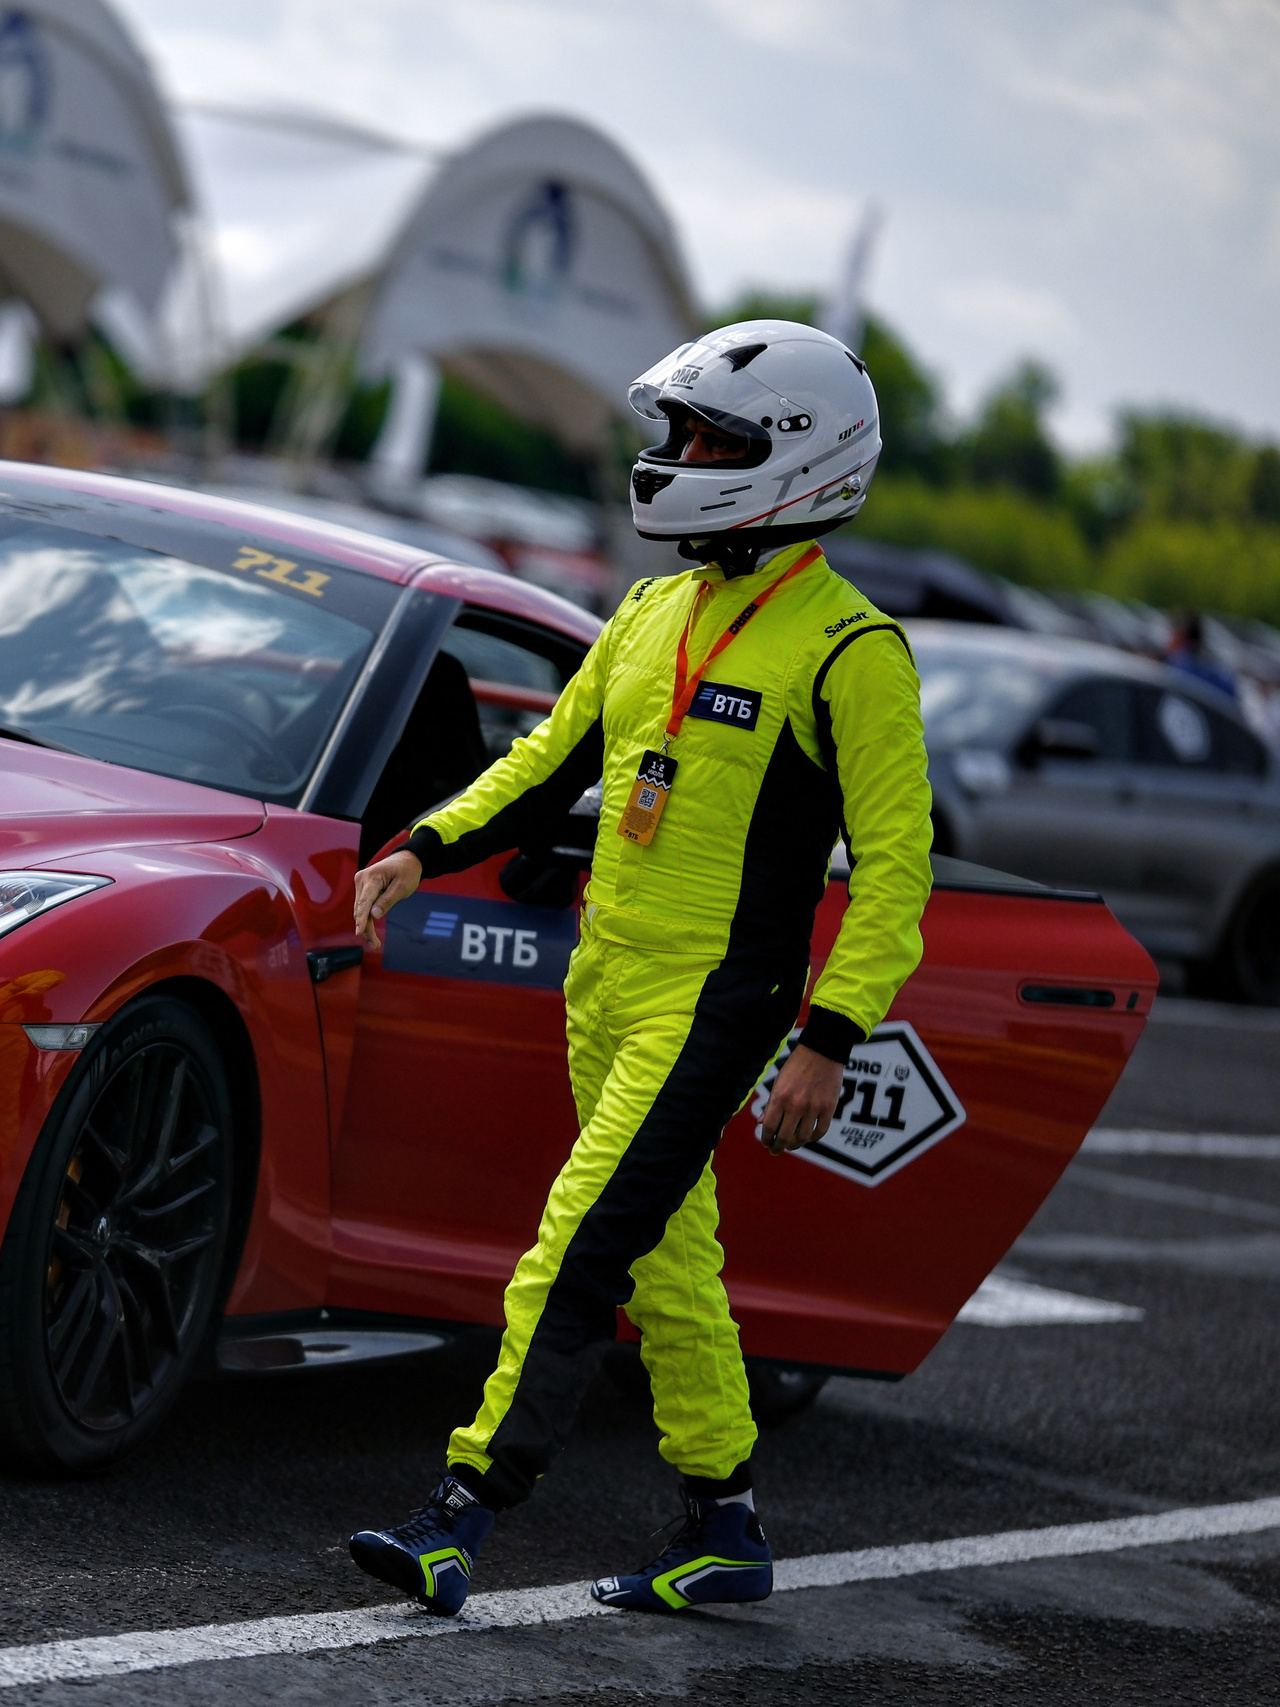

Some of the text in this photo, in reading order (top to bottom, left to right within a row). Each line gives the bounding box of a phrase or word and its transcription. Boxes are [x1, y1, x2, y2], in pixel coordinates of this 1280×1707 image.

[671, 368, 700, 384] OMP
[231, 545, 332, 597] 711
[631, 577, 662, 603] belt
[728, 602, 760, 635] RDRC
[824, 611, 869, 638] Sabelt
[711, 694, 753, 720] ВТБ
[461, 923, 539, 968] ВТБ
[844, 1058, 882, 1076] DRC
[833, 1078, 906, 1130] 711
